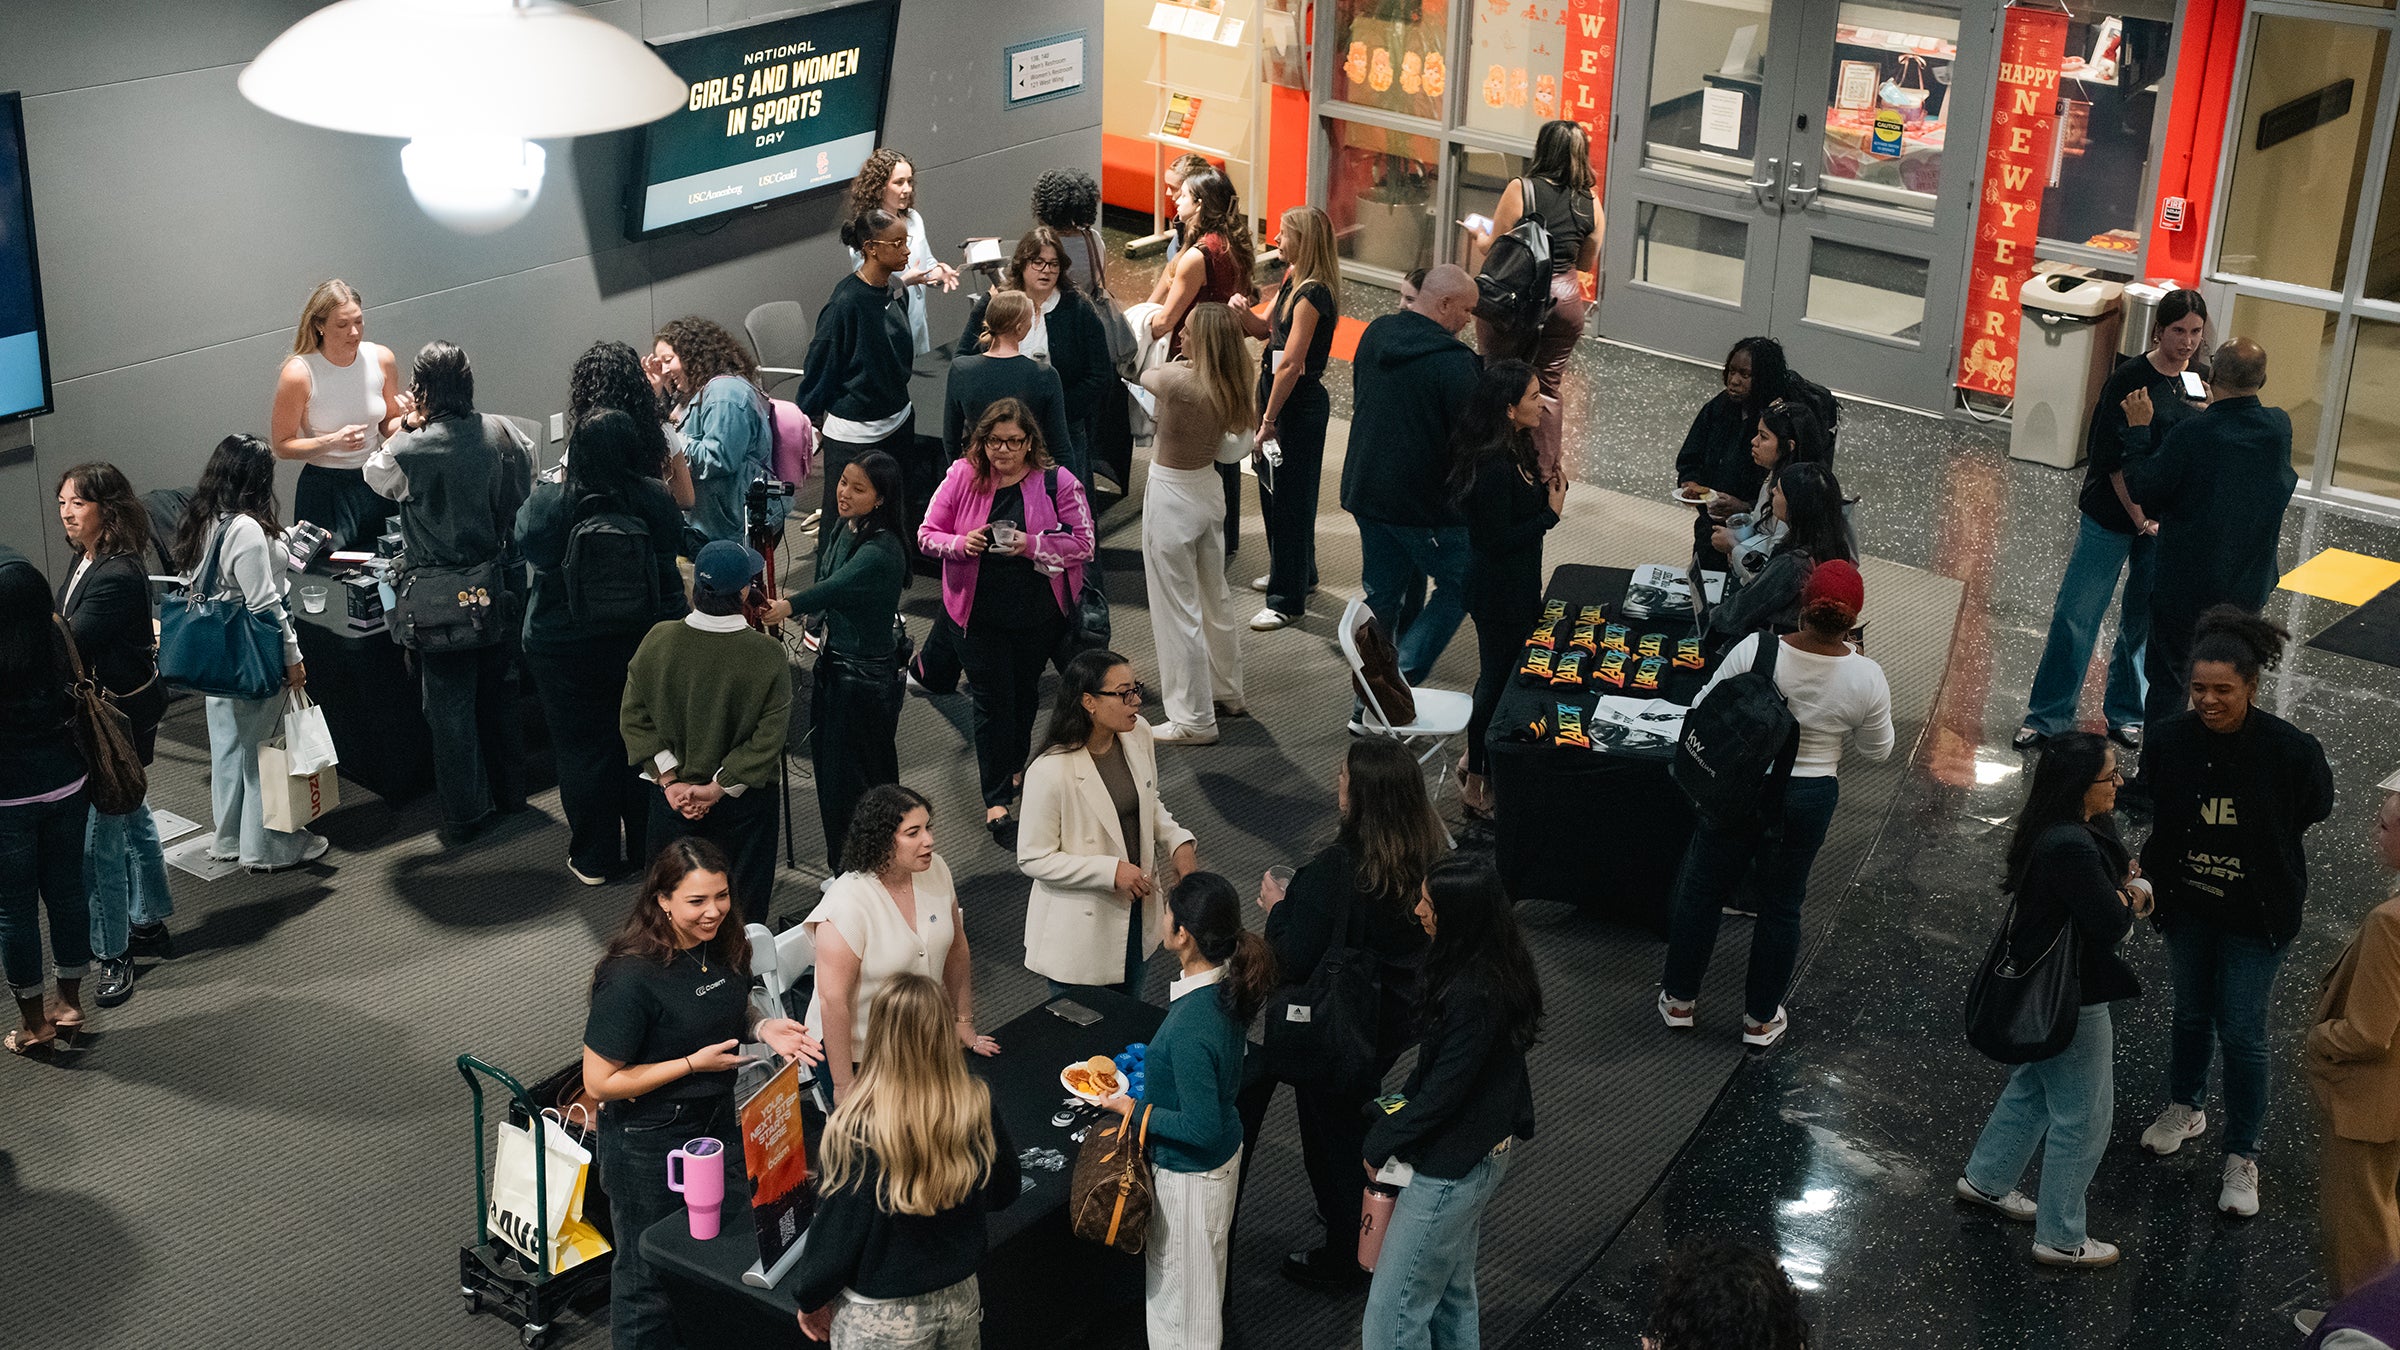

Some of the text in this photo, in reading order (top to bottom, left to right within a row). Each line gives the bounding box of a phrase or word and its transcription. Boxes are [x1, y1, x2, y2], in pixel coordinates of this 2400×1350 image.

[743, 40, 816, 66] NATIONAL
[688, 47, 860, 112] GIRLS AND WOMEN
[1999, 62, 2059, 89] HAPPY
[726, 89, 823, 137] IN SPORTS
[1876, 121, 1901, 131] CAUTION
[755, 130, 785, 148] DAY
[1984, 88, 2041, 338] NEW YEAR
[749, 1091, 798, 1143] NEXT STEP
[760, 1092, 784, 1118] YOUR
[758, 1108, 792, 1145] STARTS
[764, 1123, 788, 1151] HERE
